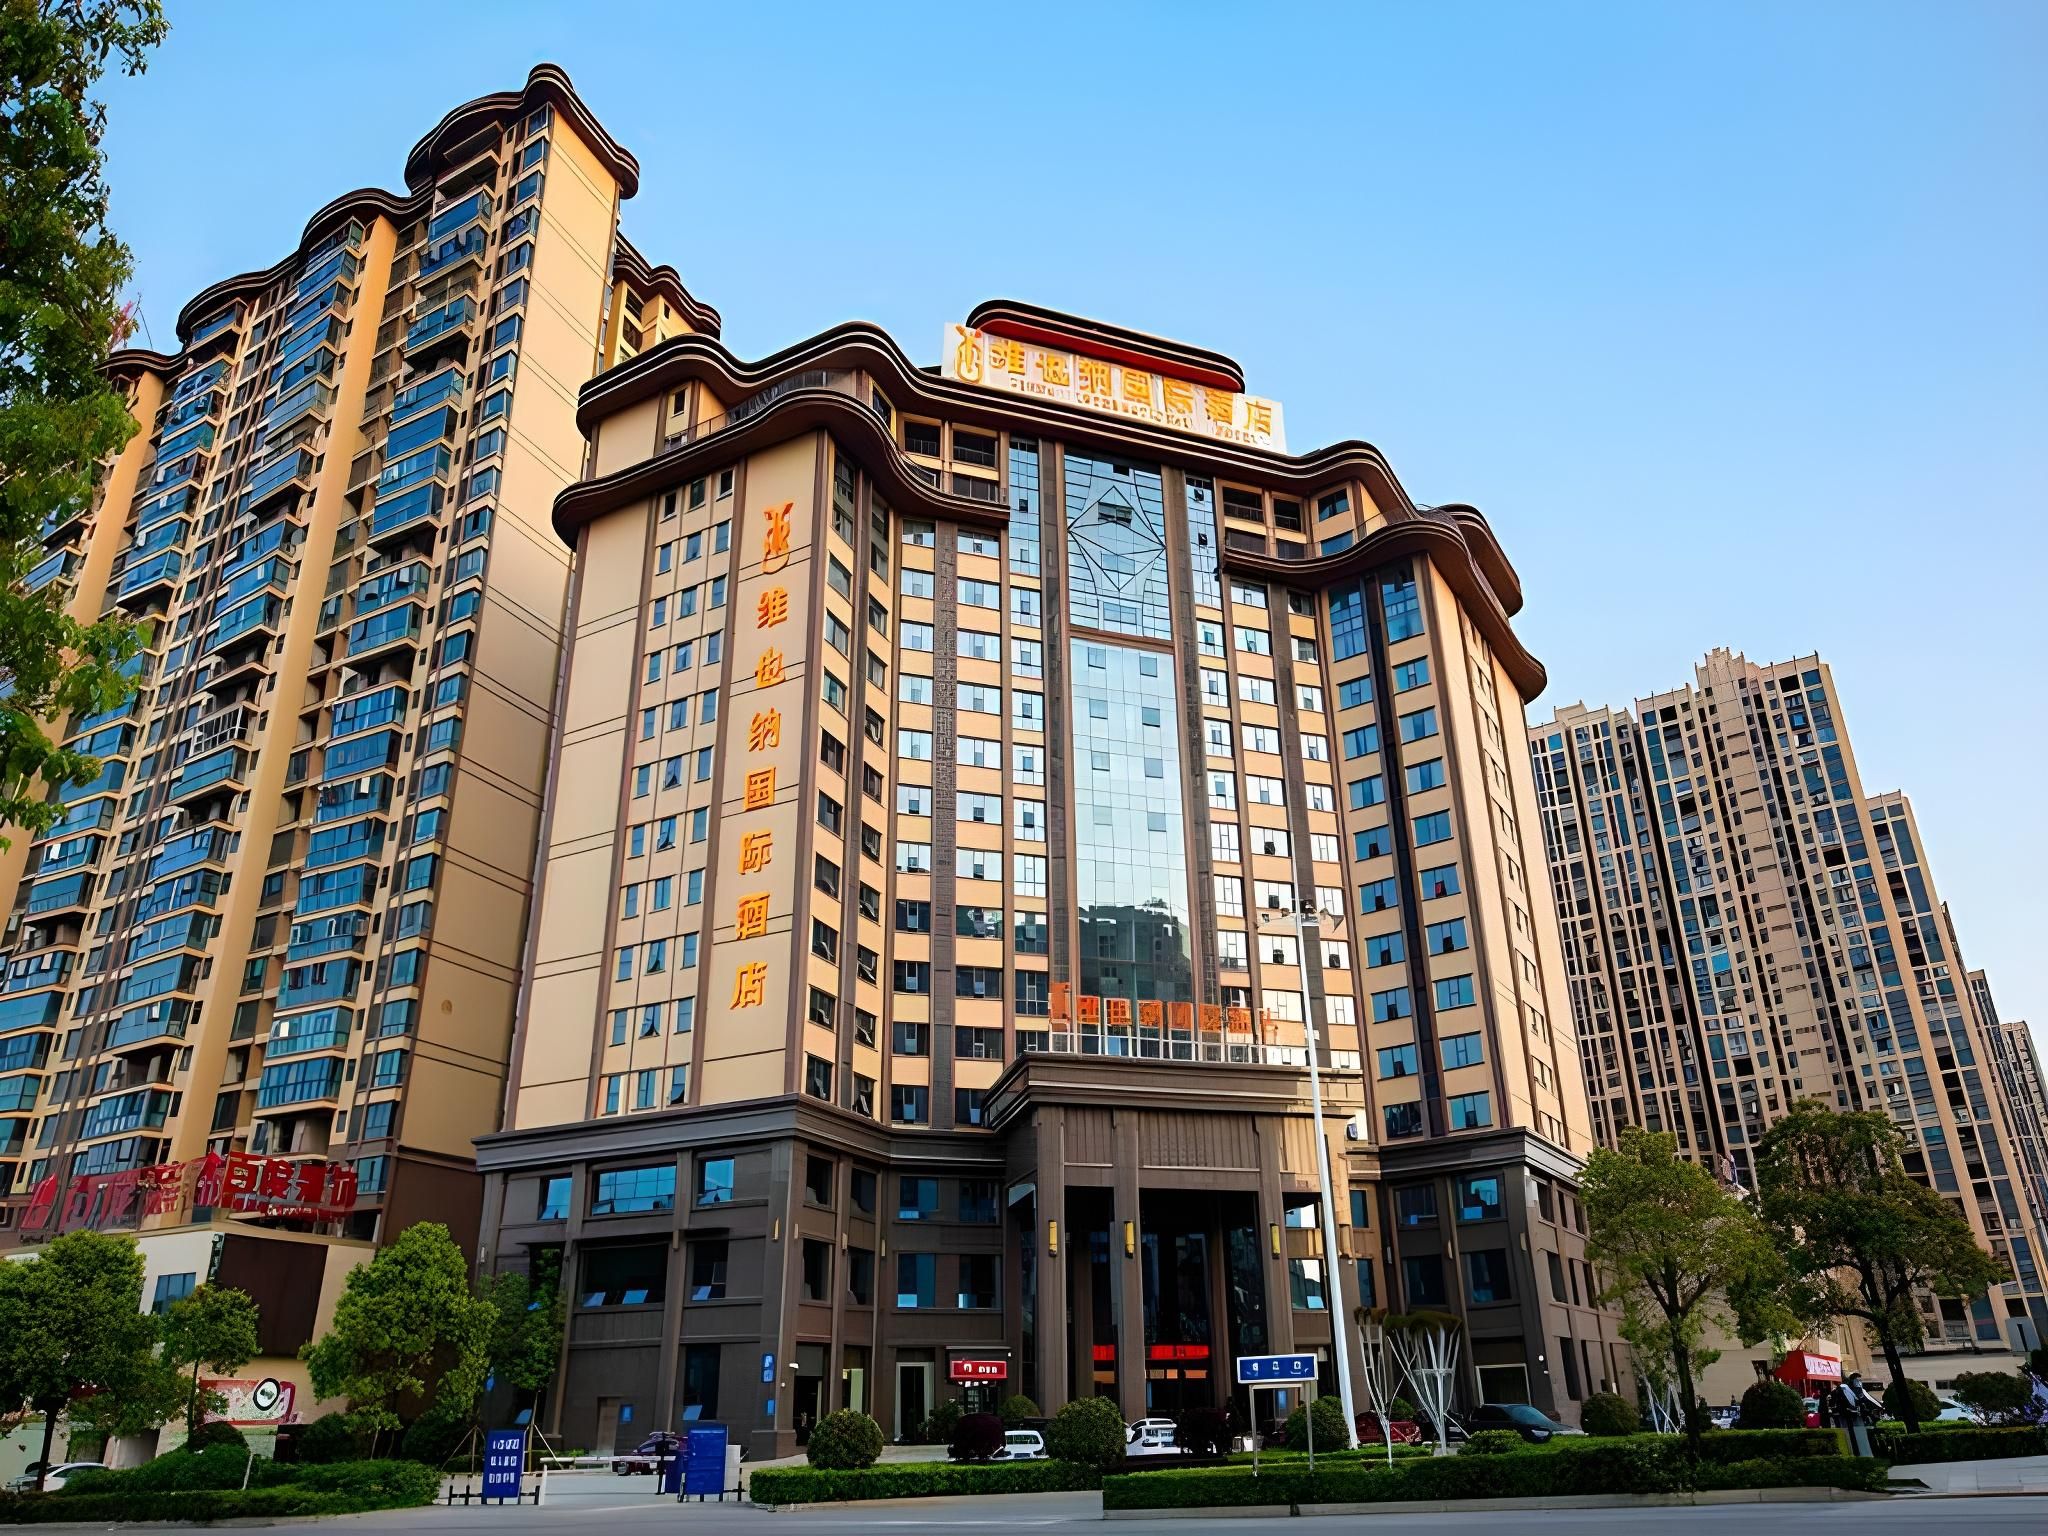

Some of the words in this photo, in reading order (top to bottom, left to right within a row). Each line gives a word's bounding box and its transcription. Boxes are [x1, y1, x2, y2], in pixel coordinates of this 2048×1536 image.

[730, 586, 789, 1010] 维也纳国际酒店
